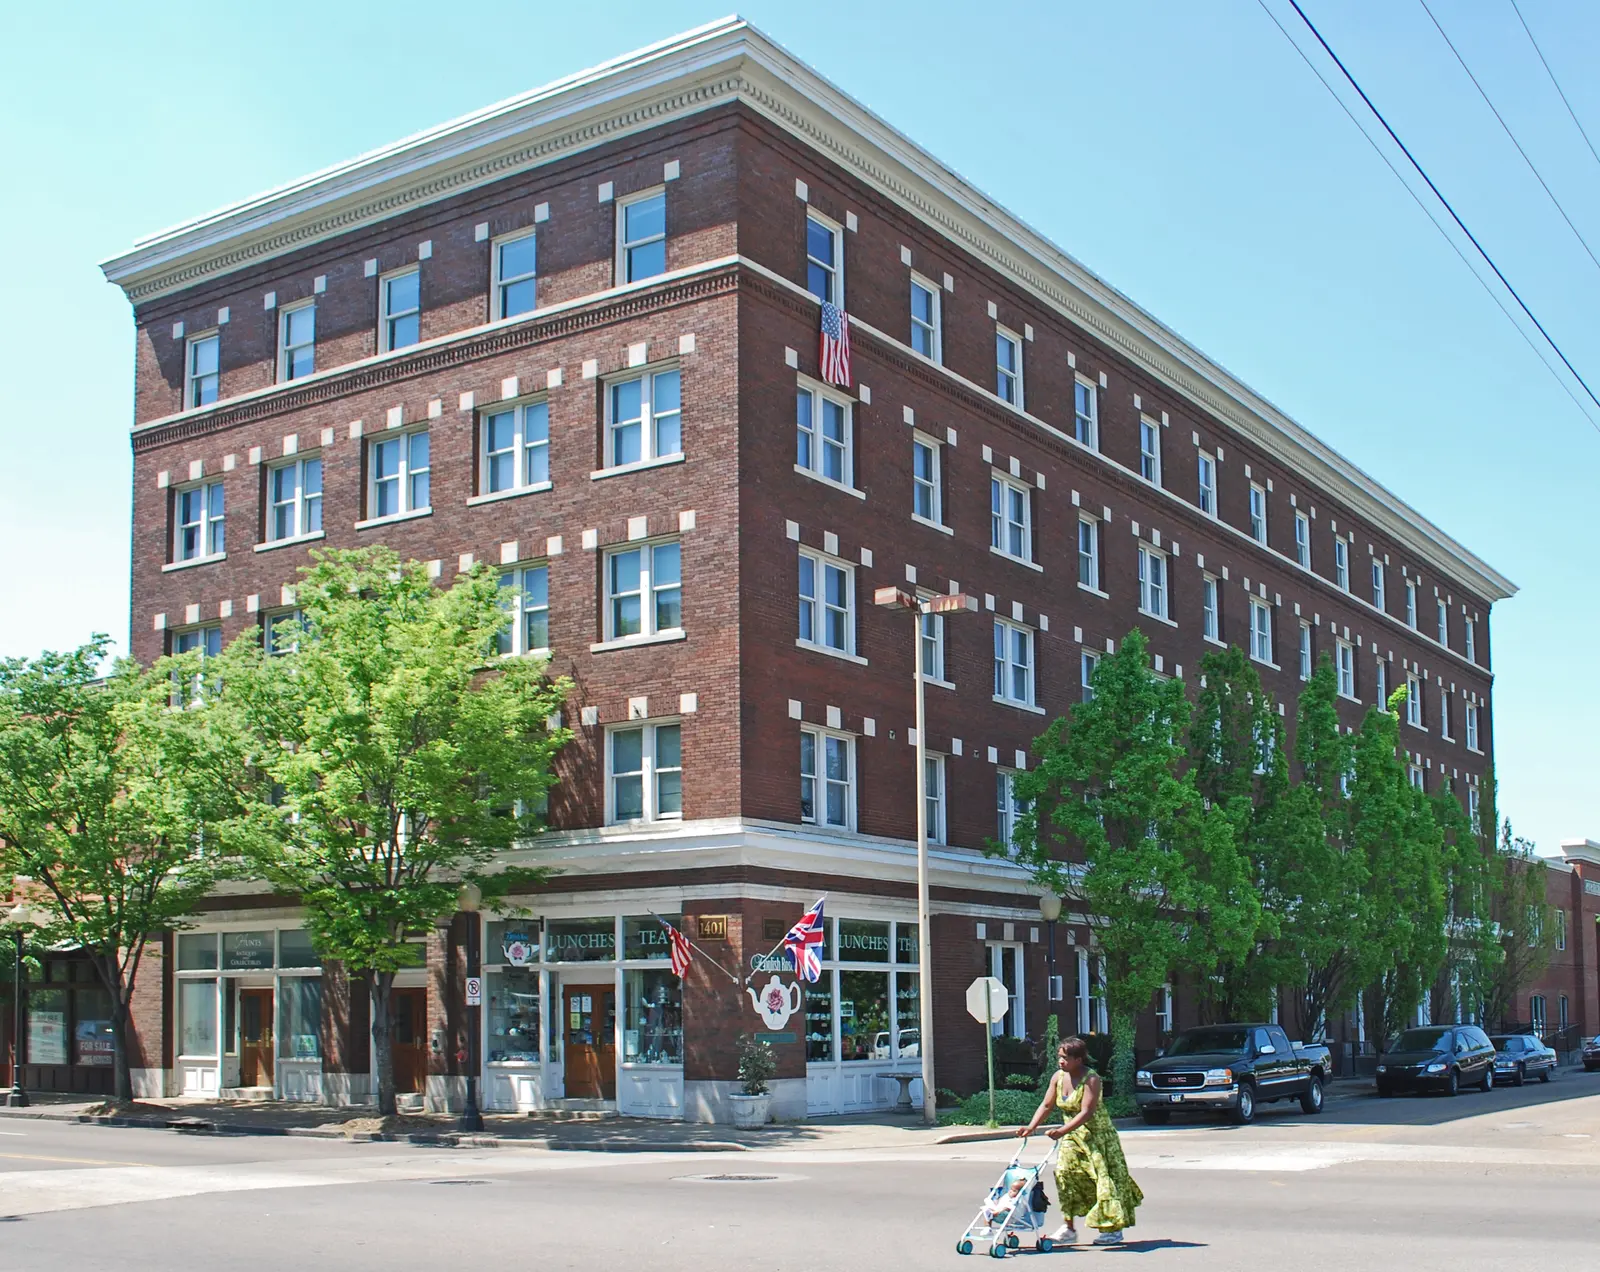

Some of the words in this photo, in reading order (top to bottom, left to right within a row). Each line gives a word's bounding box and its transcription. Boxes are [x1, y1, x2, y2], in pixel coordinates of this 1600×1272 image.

[700, 921, 723, 935] 1401
[549, 933, 616, 949] LUNCHES
[639, 930, 669, 945] TEA
[839, 935, 889, 951] LUNCHES
[898, 938, 918, 951] TEA
